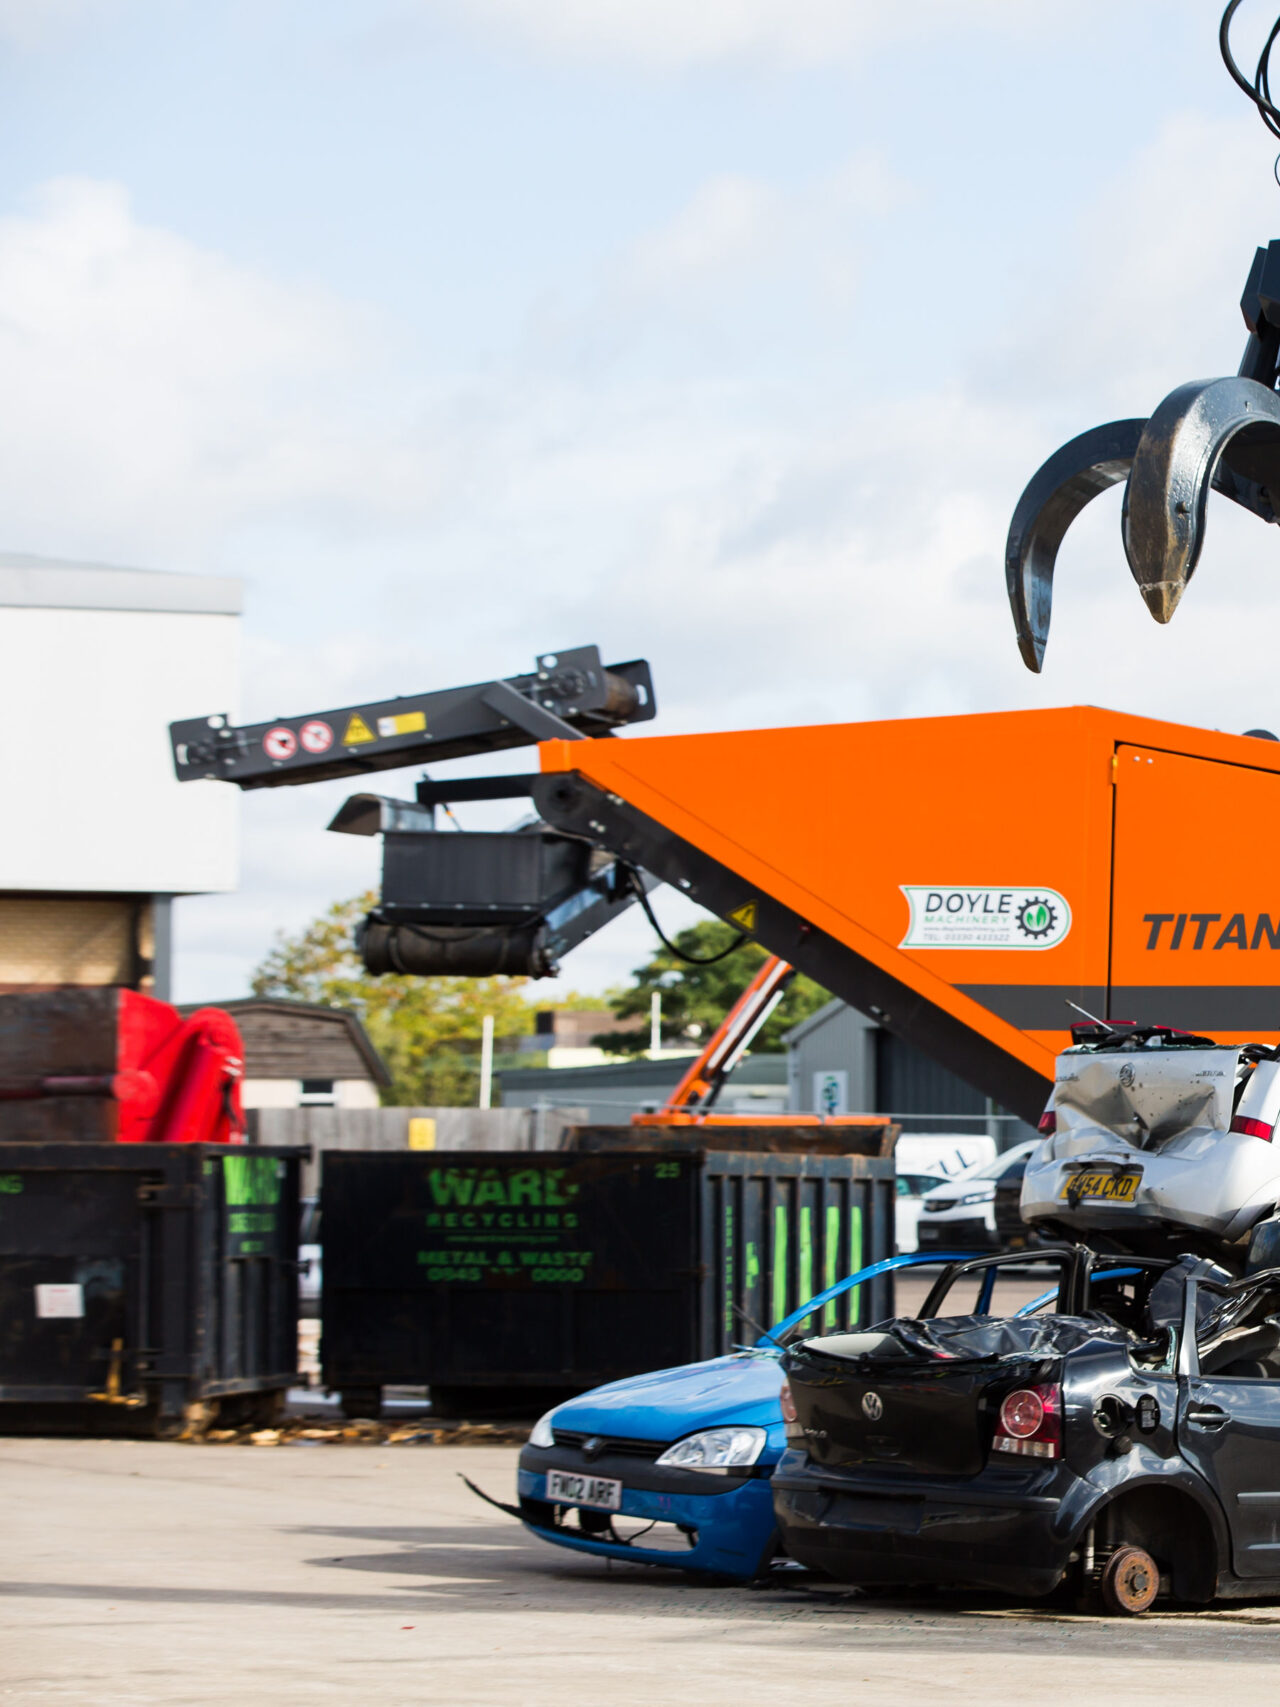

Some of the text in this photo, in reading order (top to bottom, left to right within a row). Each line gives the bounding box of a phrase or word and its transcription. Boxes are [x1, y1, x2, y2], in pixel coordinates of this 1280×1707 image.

[925, 893, 1013, 914] DOYLE
[923, 915, 1010, 925] MACHINERY
[654, 1162, 681, 1178] 25
[425, 1213, 579, 1228] RECYCLING
[417, 1251, 491, 1266] METAL
[519, 1251, 595, 1266] WASTE
